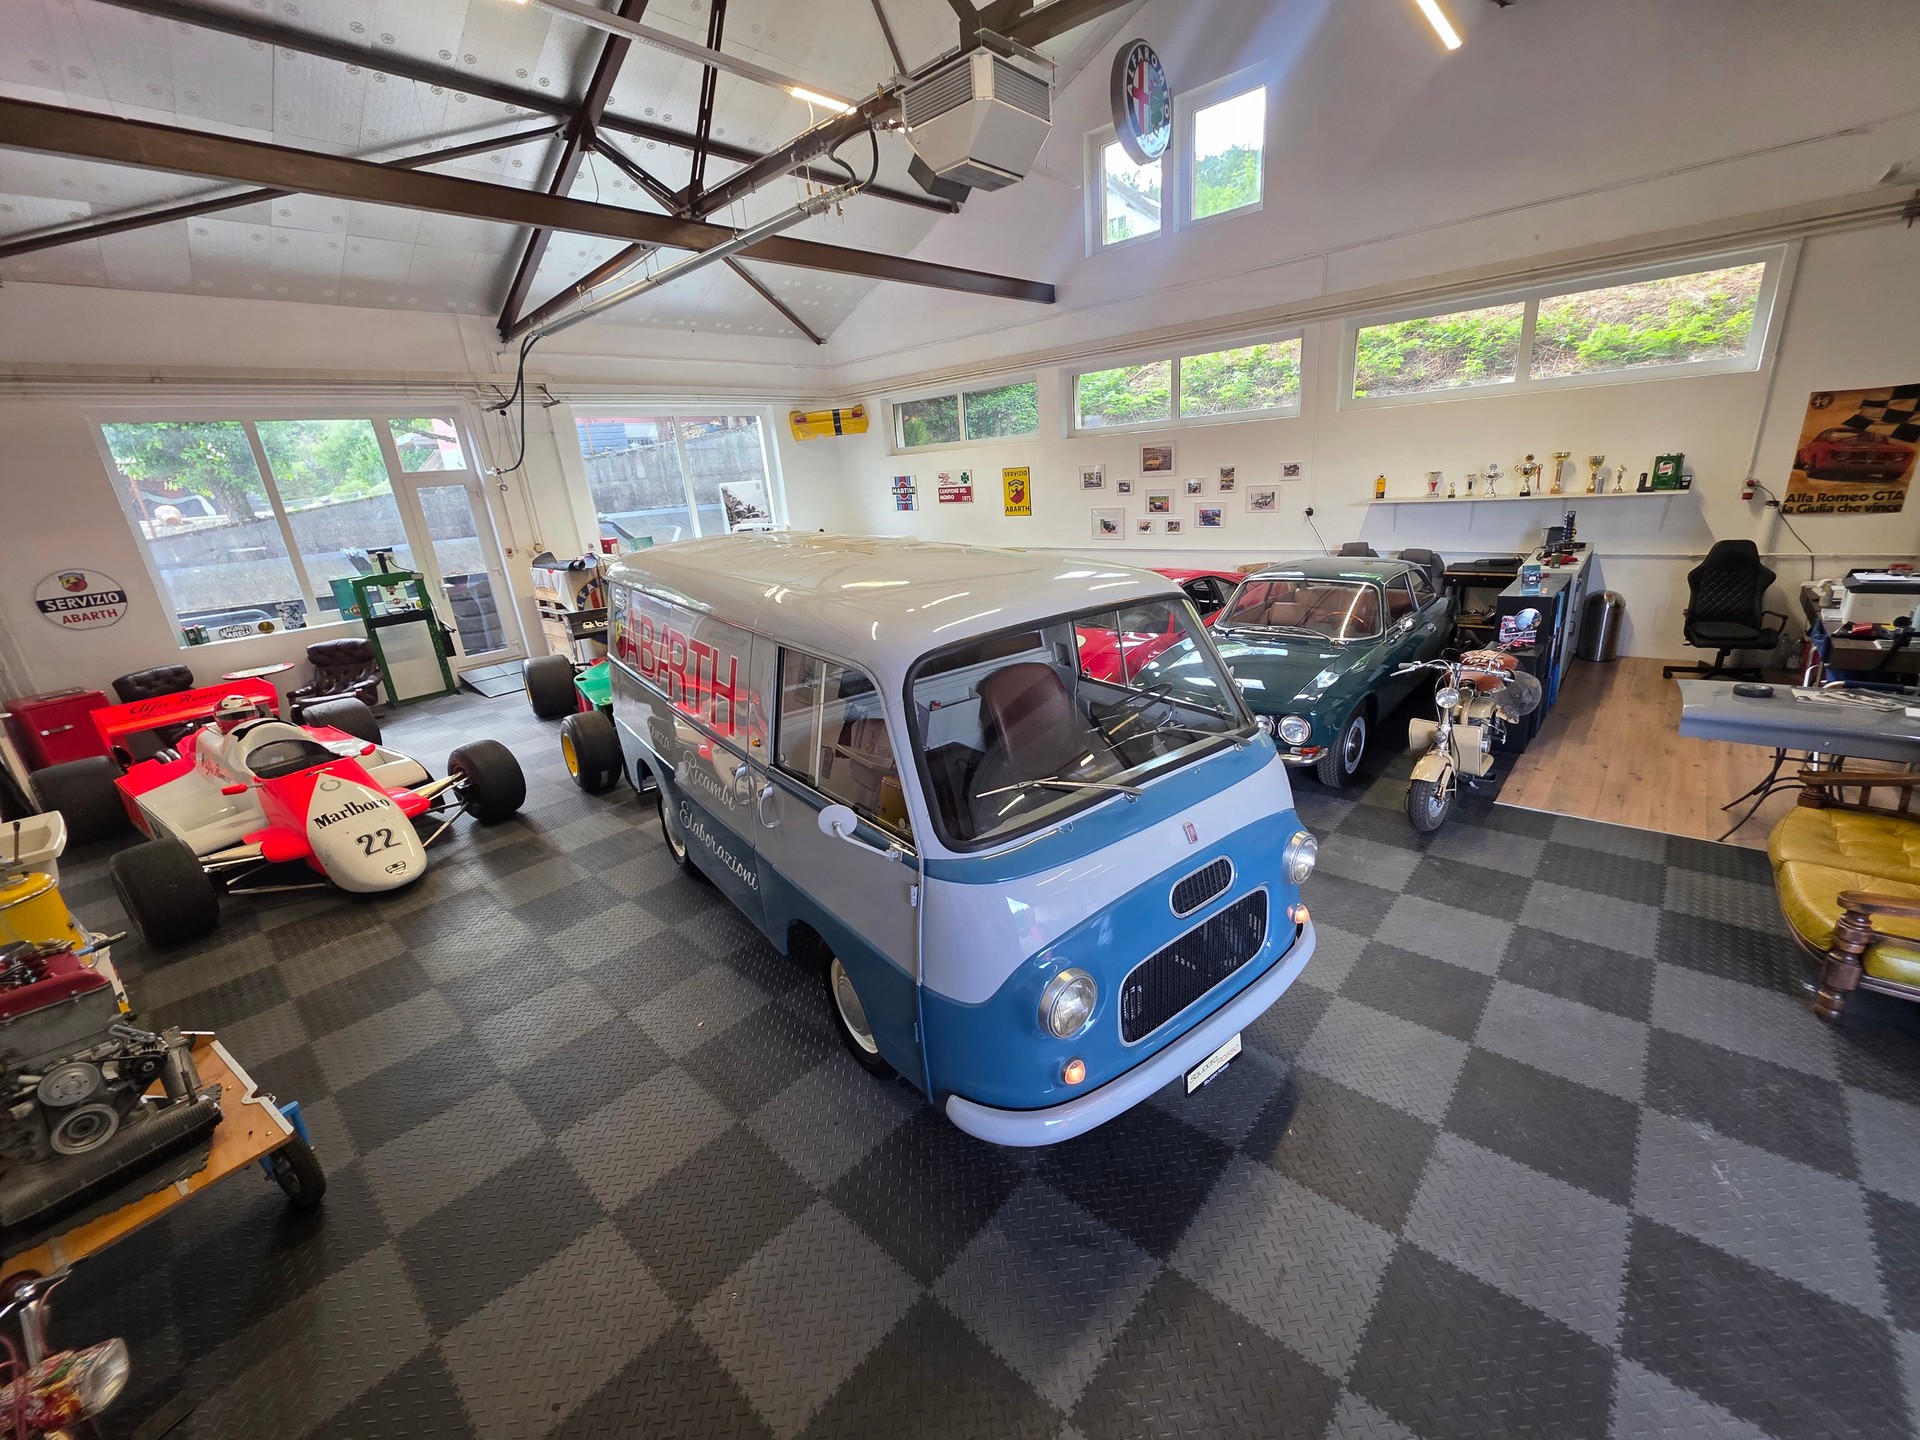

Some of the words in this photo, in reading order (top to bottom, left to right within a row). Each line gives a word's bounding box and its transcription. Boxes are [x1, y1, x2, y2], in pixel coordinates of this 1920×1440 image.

[1127, 47, 1144, 97] ALFA
[1144, 47, 1169, 118] ROMEO
[1782, 504, 1795, 514] la
[1797, 502, 1834, 514] Giulia
[1837, 503, 1861, 513] che
[1864, 502, 1903, 514] vince
[1785, 493, 1815, 503] Alfa
[1816, 492, 1868, 502] Romeo
[1872, 490, 1904, 501] GTA
[45, 592, 119, 611] SERVIZIO
[62, 608, 118, 624] ABARTH
[626, 608, 739, 738] ABARTH
[129, 701, 169, 718] Alfa
[682, 750, 735, 811] Ricambi
[313, 799, 390, 829] Marlboro
[356, 828, 402, 857] 22
[680, 800, 759, 891] Elaborazioni
